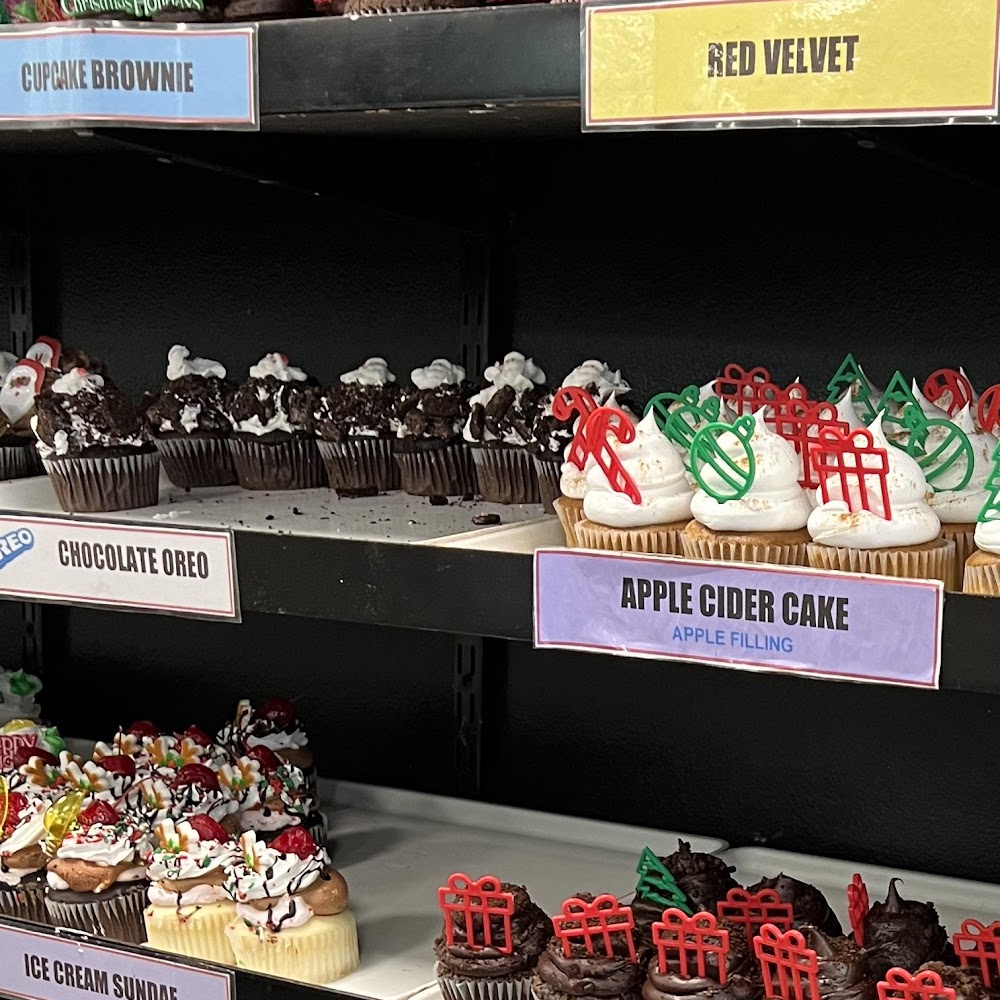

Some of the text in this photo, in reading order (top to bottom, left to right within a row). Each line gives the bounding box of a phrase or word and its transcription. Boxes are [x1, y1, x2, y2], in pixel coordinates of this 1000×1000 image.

[21, 59, 194, 92] CUPCAKE BROWNIE
[708, 35, 859, 77] RED VELVET
[58, 540, 209, 579] CHOCOLATE OREO
[621, 577, 849, 631] APPLE CIDER CAKE
[672, 625, 793, 653] APPLE FILLING
[24, 953, 50, 982] ICE
[54, 961, 109, 995] CREAM
